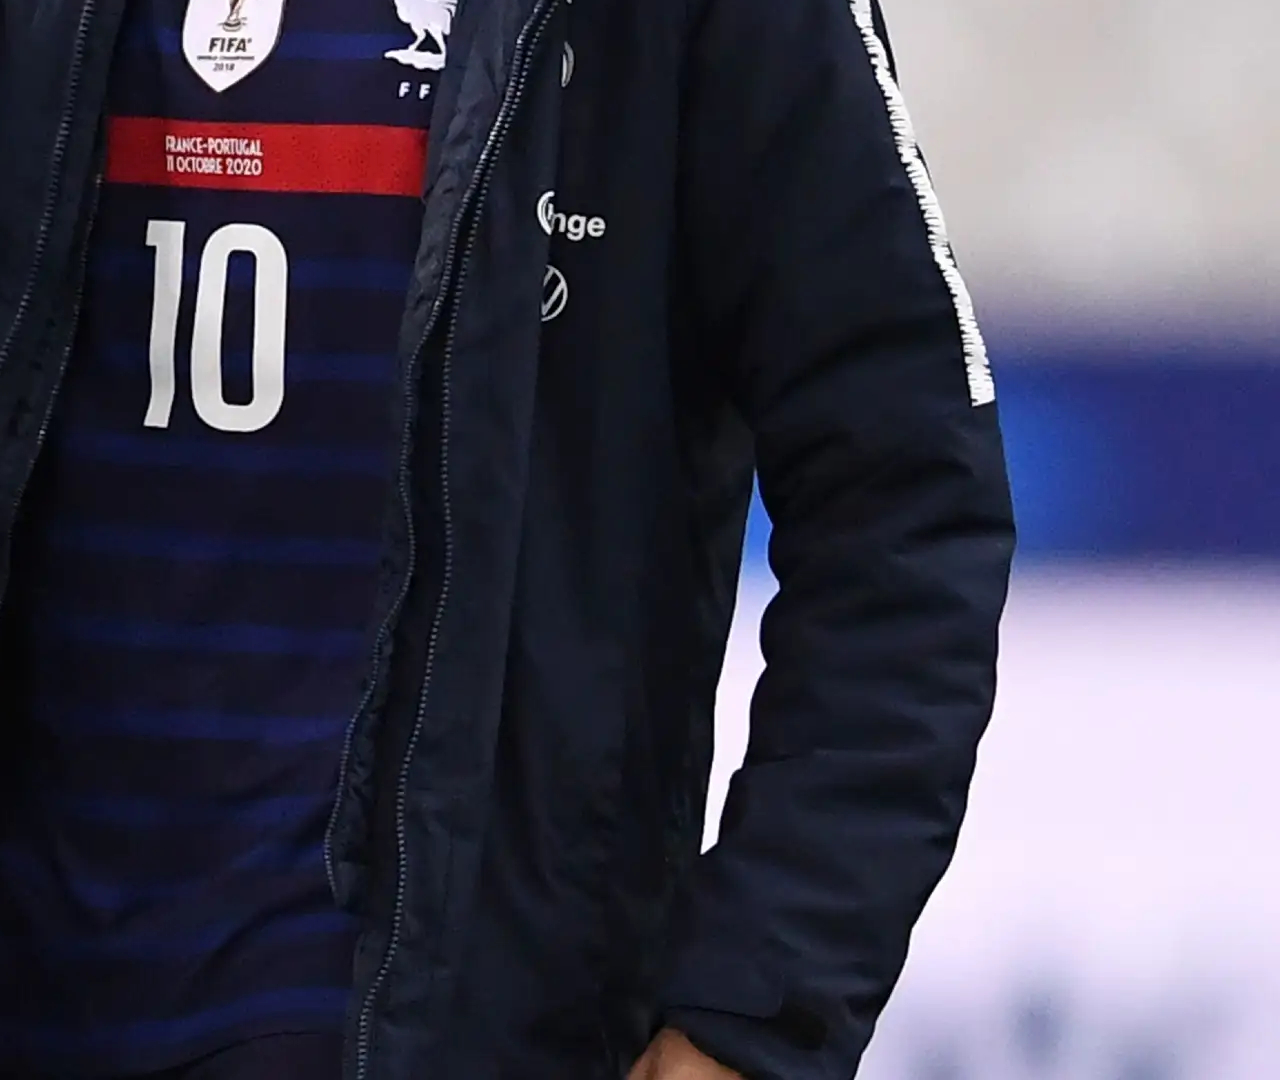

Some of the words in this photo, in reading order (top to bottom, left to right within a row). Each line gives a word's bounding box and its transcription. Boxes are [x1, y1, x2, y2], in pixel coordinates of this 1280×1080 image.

[208, 37, 247, 53] FIFA
[399, 81, 431, 100] FF
[165, 135, 263, 156] FRANCE-PORTUGAL
[166, 155, 174, 172] 11
[176, 156, 223, 174] OCTOBRE
[226, 157, 262, 176] 2020
[551, 212, 607, 241] nge
[143, 220, 287, 433] 10
